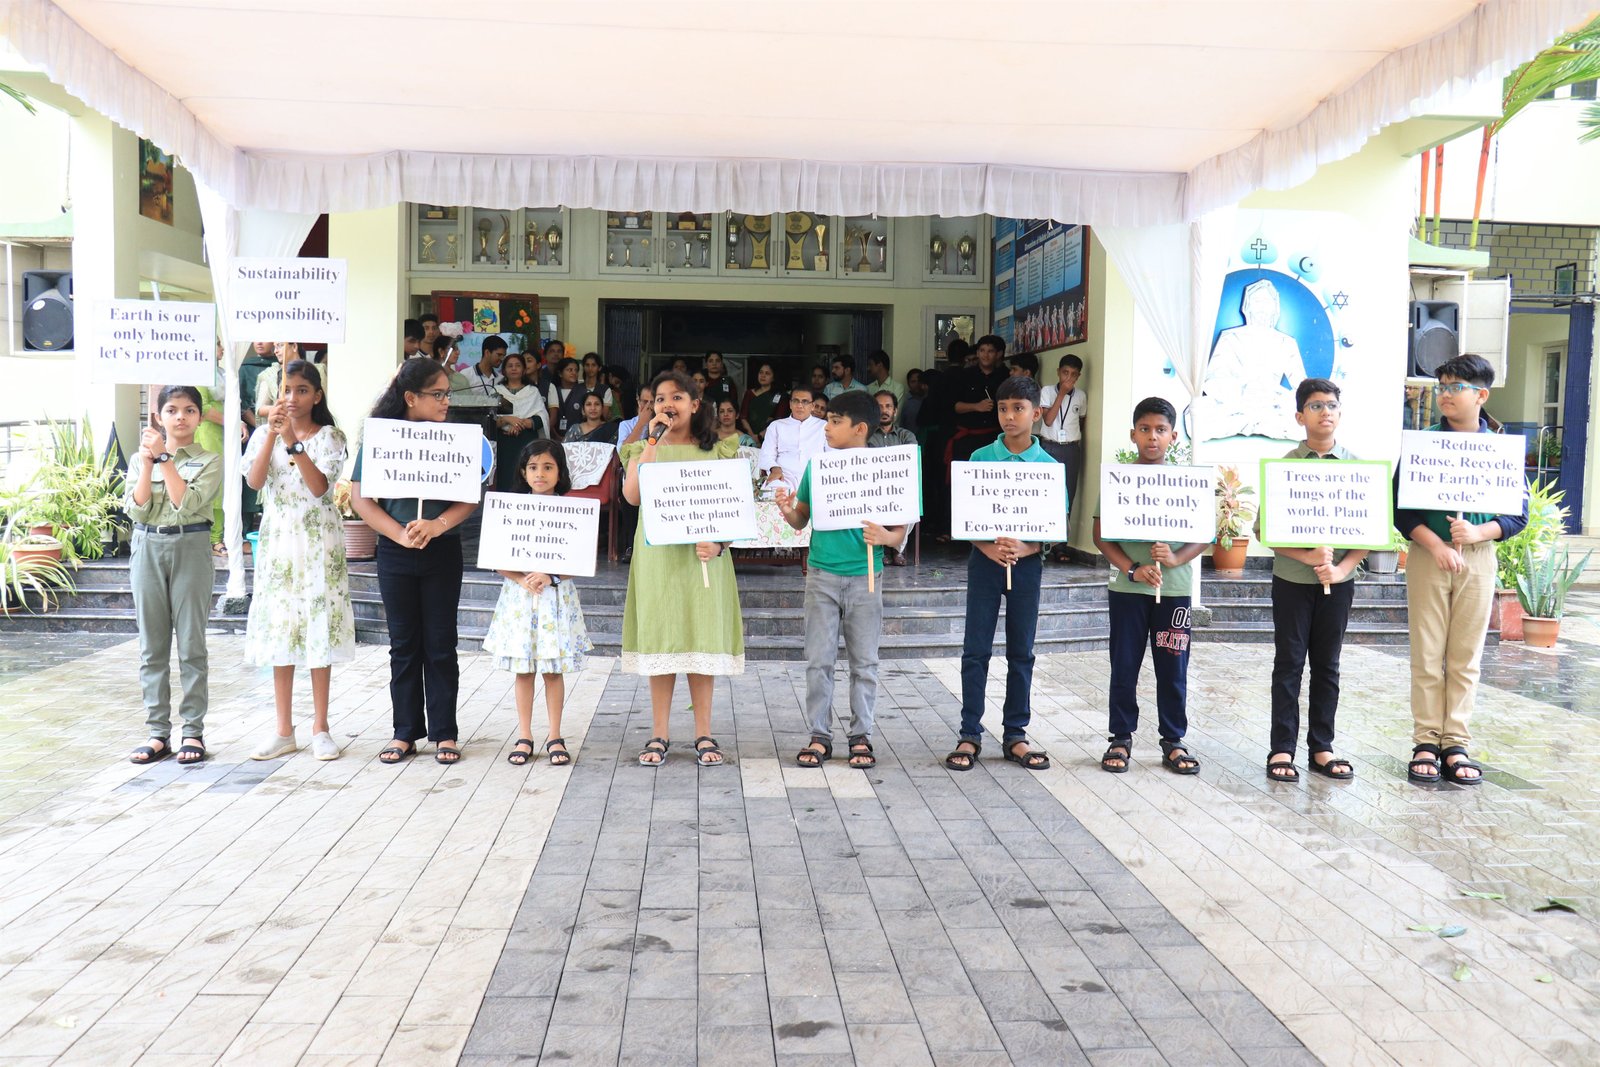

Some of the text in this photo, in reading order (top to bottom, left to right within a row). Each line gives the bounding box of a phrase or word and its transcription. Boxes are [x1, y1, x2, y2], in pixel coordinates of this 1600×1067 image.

[238, 266, 340, 284] Sustainability
[275, 290, 300, 300] our
[110, 308, 200, 322] Earth is our
[236, 308, 339, 325] responsibility.
[114, 328, 195, 344] only home,
[100, 347, 208, 363] let’s protect it.
[392, 427, 456, 445] “Healthy
[372, 447, 473, 467] Earth Healthy
[819, 453, 911, 469] Keep the oceans
[1460, 457, 1517, 471] Recycle.
[383, 469, 461, 484] Mankind.”
[680, 469, 712, 478] Better
[822, 469, 909, 485] blue, the planet
[964, 469, 1055, 482] “Think green,
[1109, 472, 1208, 488] No pollution
[1284, 471, 1370, 483] Trees are the
[1408, 471, 1518, 487] The Earth’s life
[663, 482, 732, 493] environment,
[826, 485, 904, 503] green and the
[971, 486, 999, 496] Live
[1004, 489, 1039, 499] green
[1118, 492, 1199, 512] is the only
[1290, 488, 1365, 502] lungs of the
[489, 499, 594, 515] The environment
[654, 499, 686, 508] Better
[829, 501, 902, 517] animals safe.
[992, 504, 1028, 514] Be an
[661, 510, 740, 522] Save the planet
[1287, 506, 1367, 518] world. Plant
[503, 515, 578, 530] is not yours,
[965, 521, 1056, 532] Eco-warrior.”
[1124, 514, 1193, 529] solution.
[686, 524, 720, 534] Earth.
[1292, 525, 1364, 535] more trees.
[535, 534, 568, 544] mine.
[511, 547, 565, 560] It’s ours.
